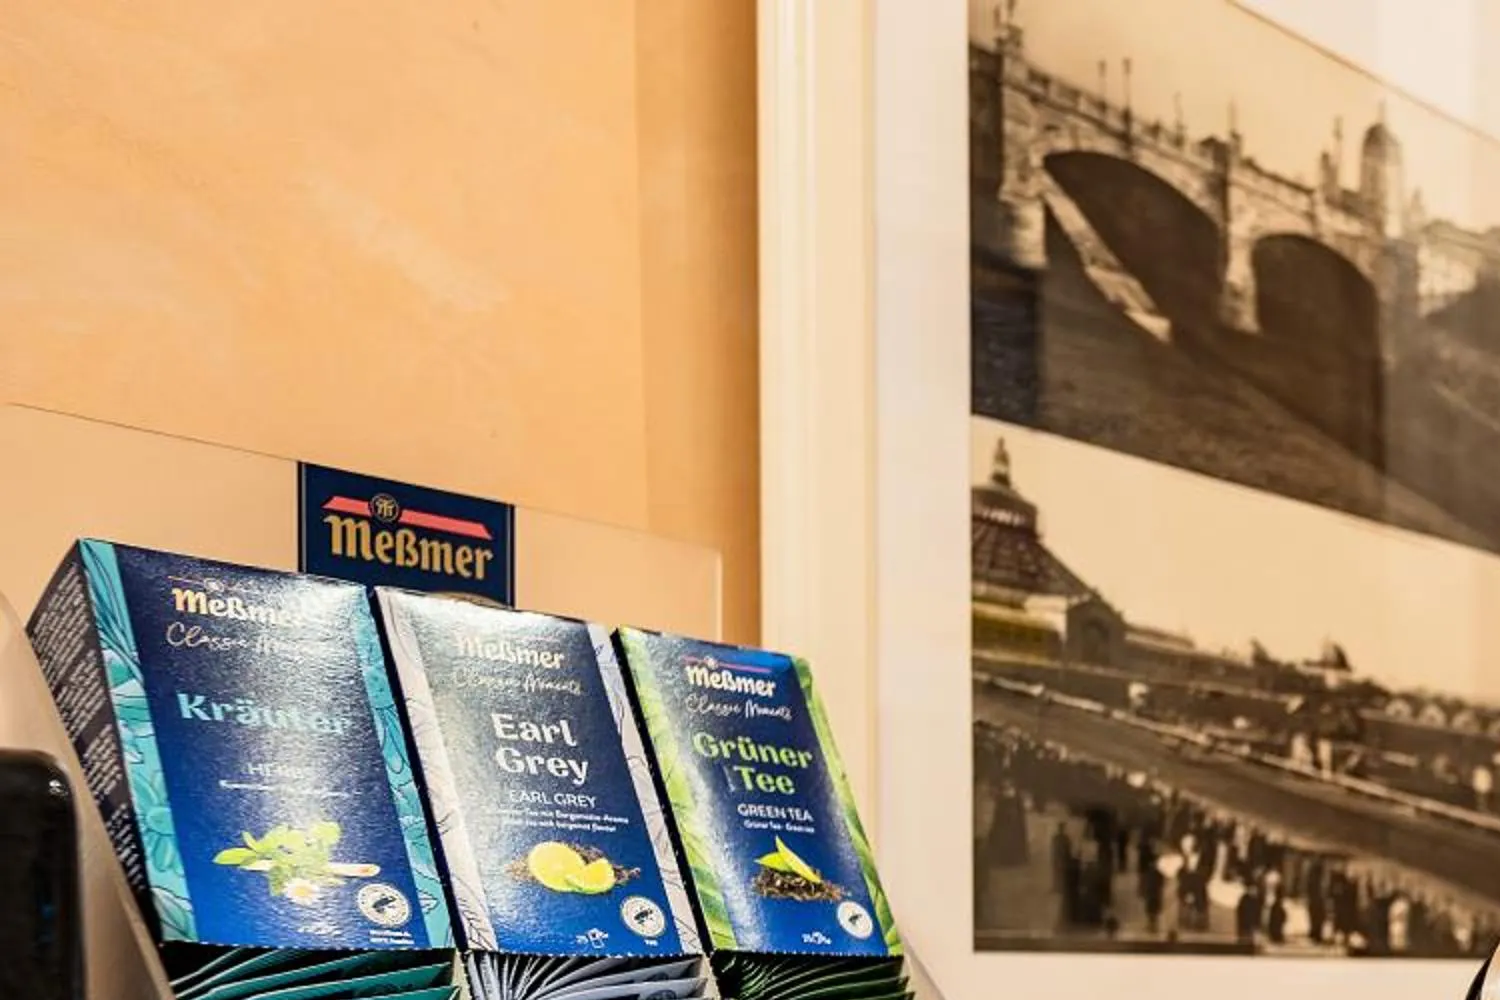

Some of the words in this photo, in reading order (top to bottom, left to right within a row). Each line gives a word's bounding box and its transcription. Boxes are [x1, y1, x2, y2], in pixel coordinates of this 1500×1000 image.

[323, 514, 494, 580] Meßmer
[172, 587, 301, 628] Meßme
[685, 665, 777, 697] Meßmer
[491, 713, 577, 747] Earl
[495, 747, 589, 785] Grey
[693, 731, 813, 769] Grüner
[733, 765, 795, 795] Tee
[508, 789, 551, 805] EARL
[554, 793, 598, 809] GREY
[737, 803, 786, 819] GREEN
[788, 807, 815, 822] TEA
